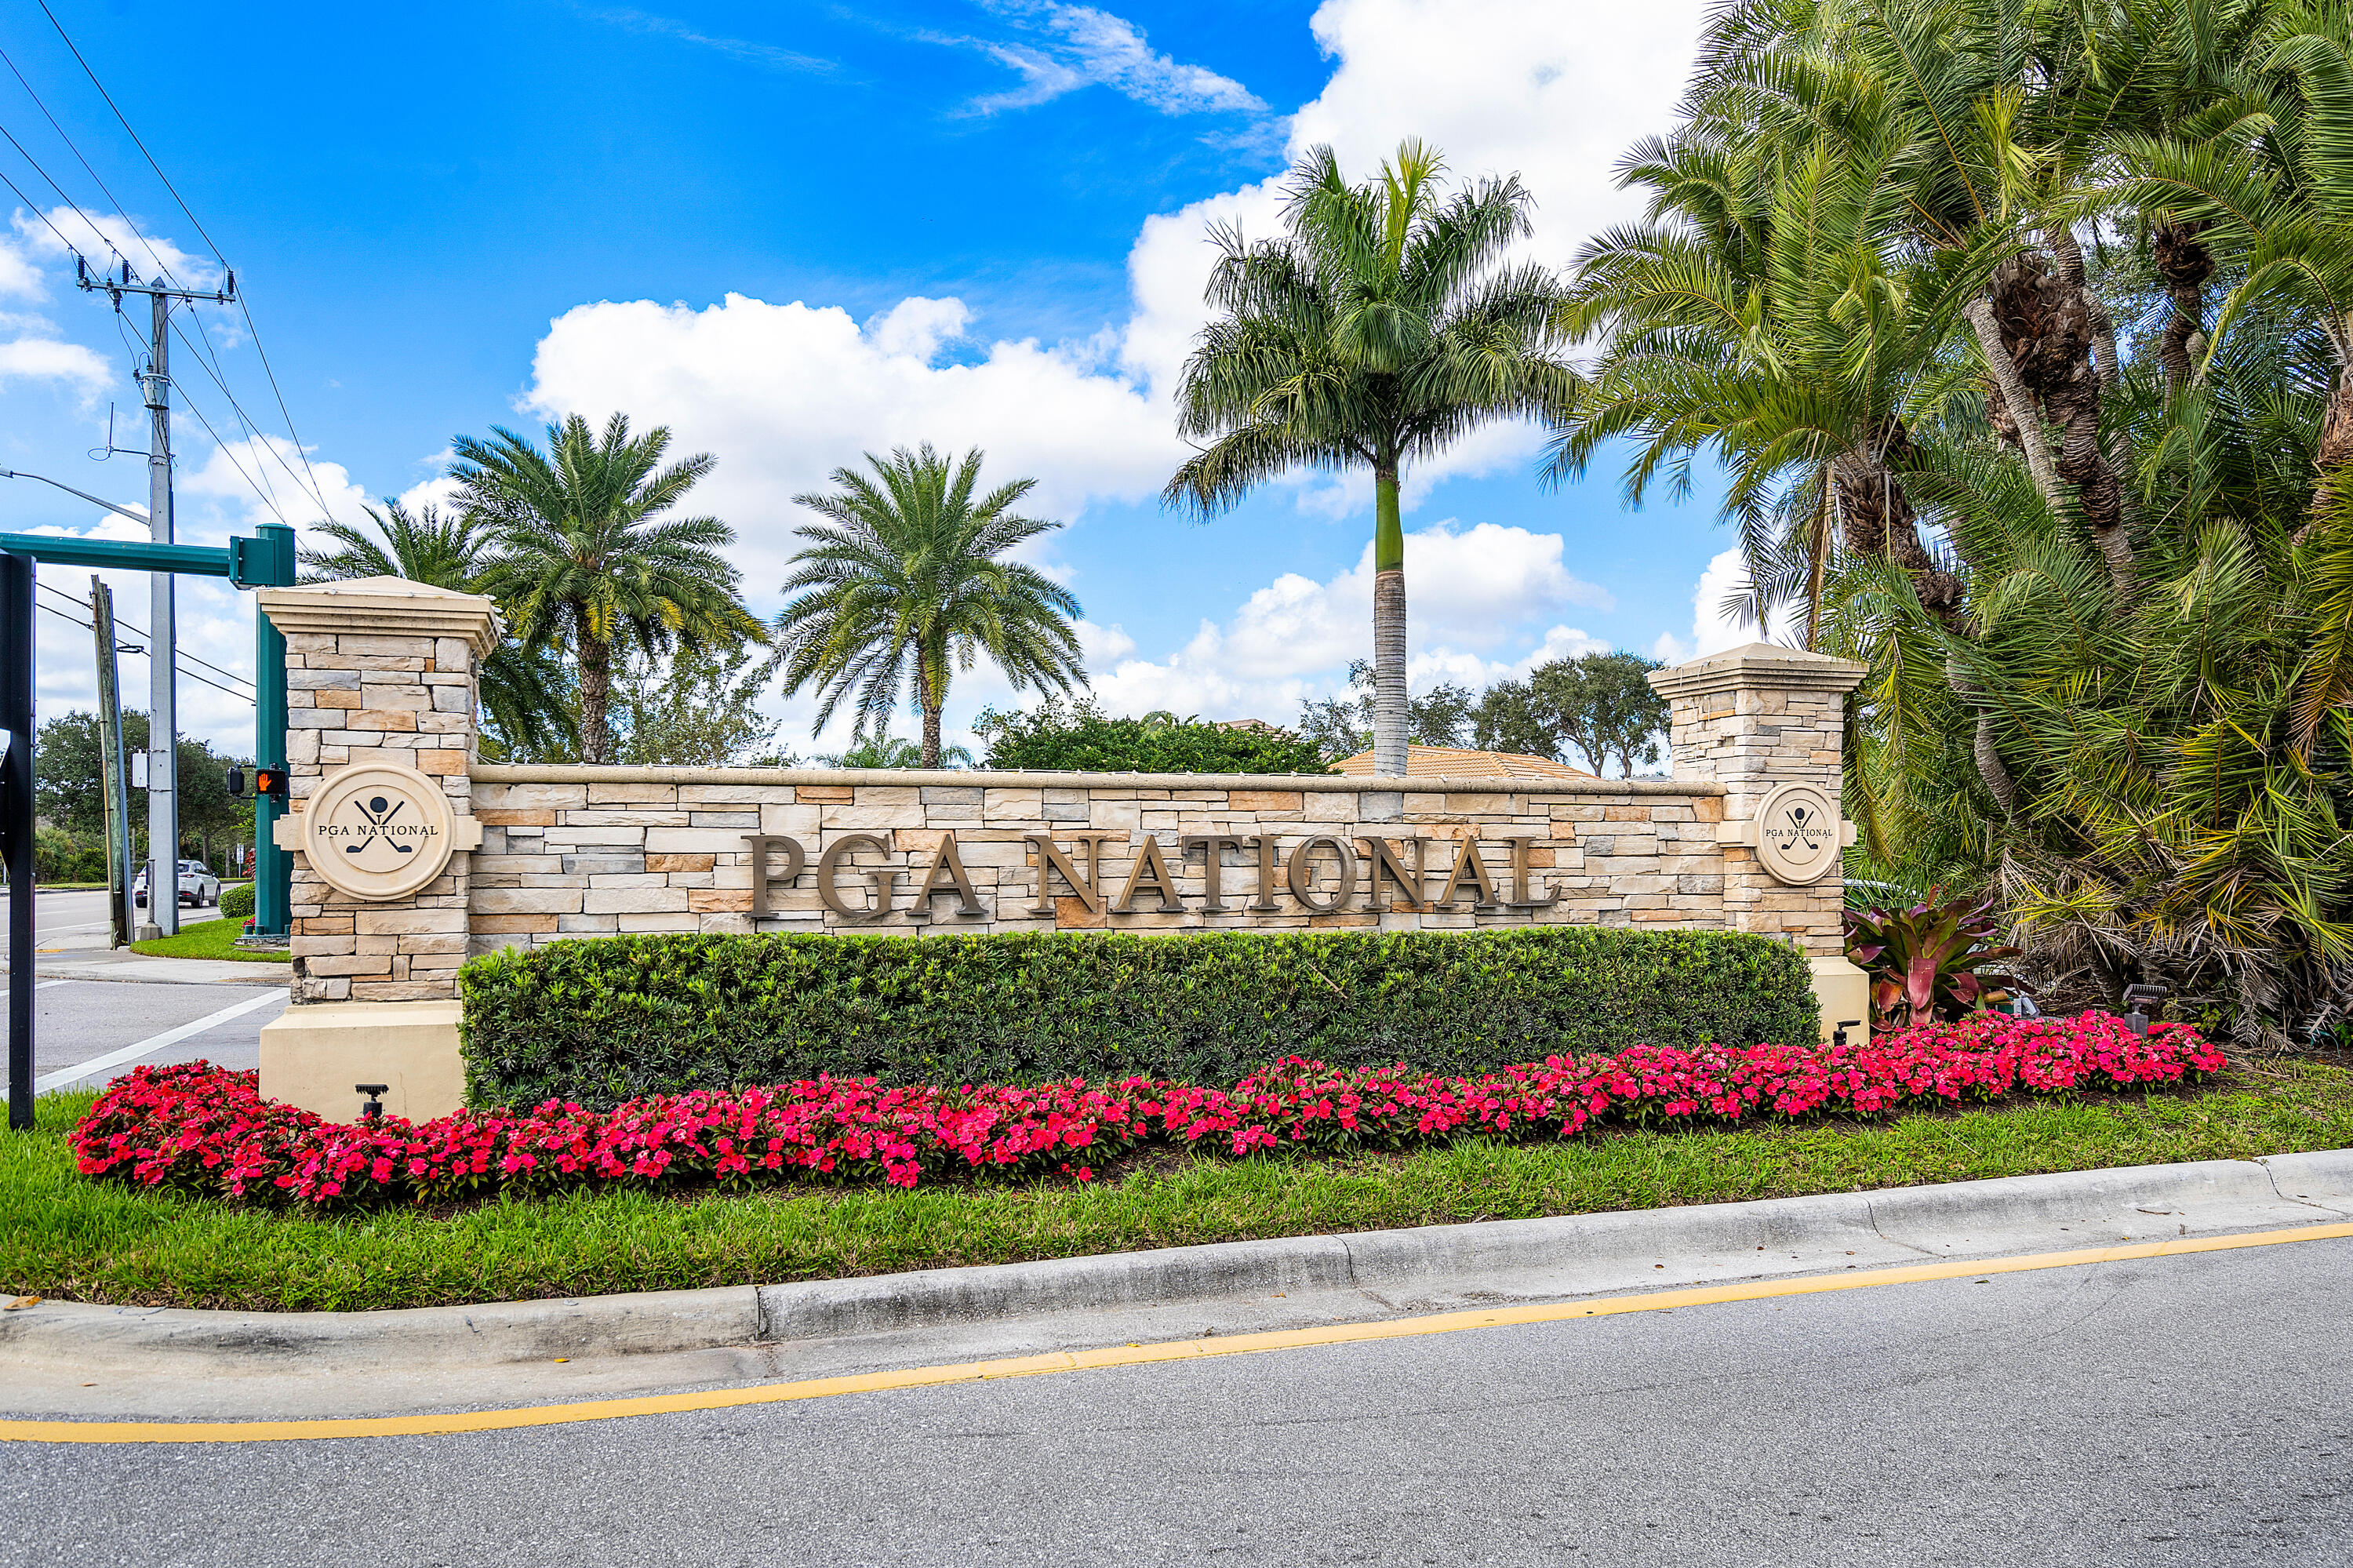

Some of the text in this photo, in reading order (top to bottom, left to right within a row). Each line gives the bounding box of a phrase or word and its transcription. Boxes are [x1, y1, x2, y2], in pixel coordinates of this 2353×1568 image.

[318, 826, 438, 835] PGA NATIONAL
[740, 833, 1562, 918] PGA NATIONAL
